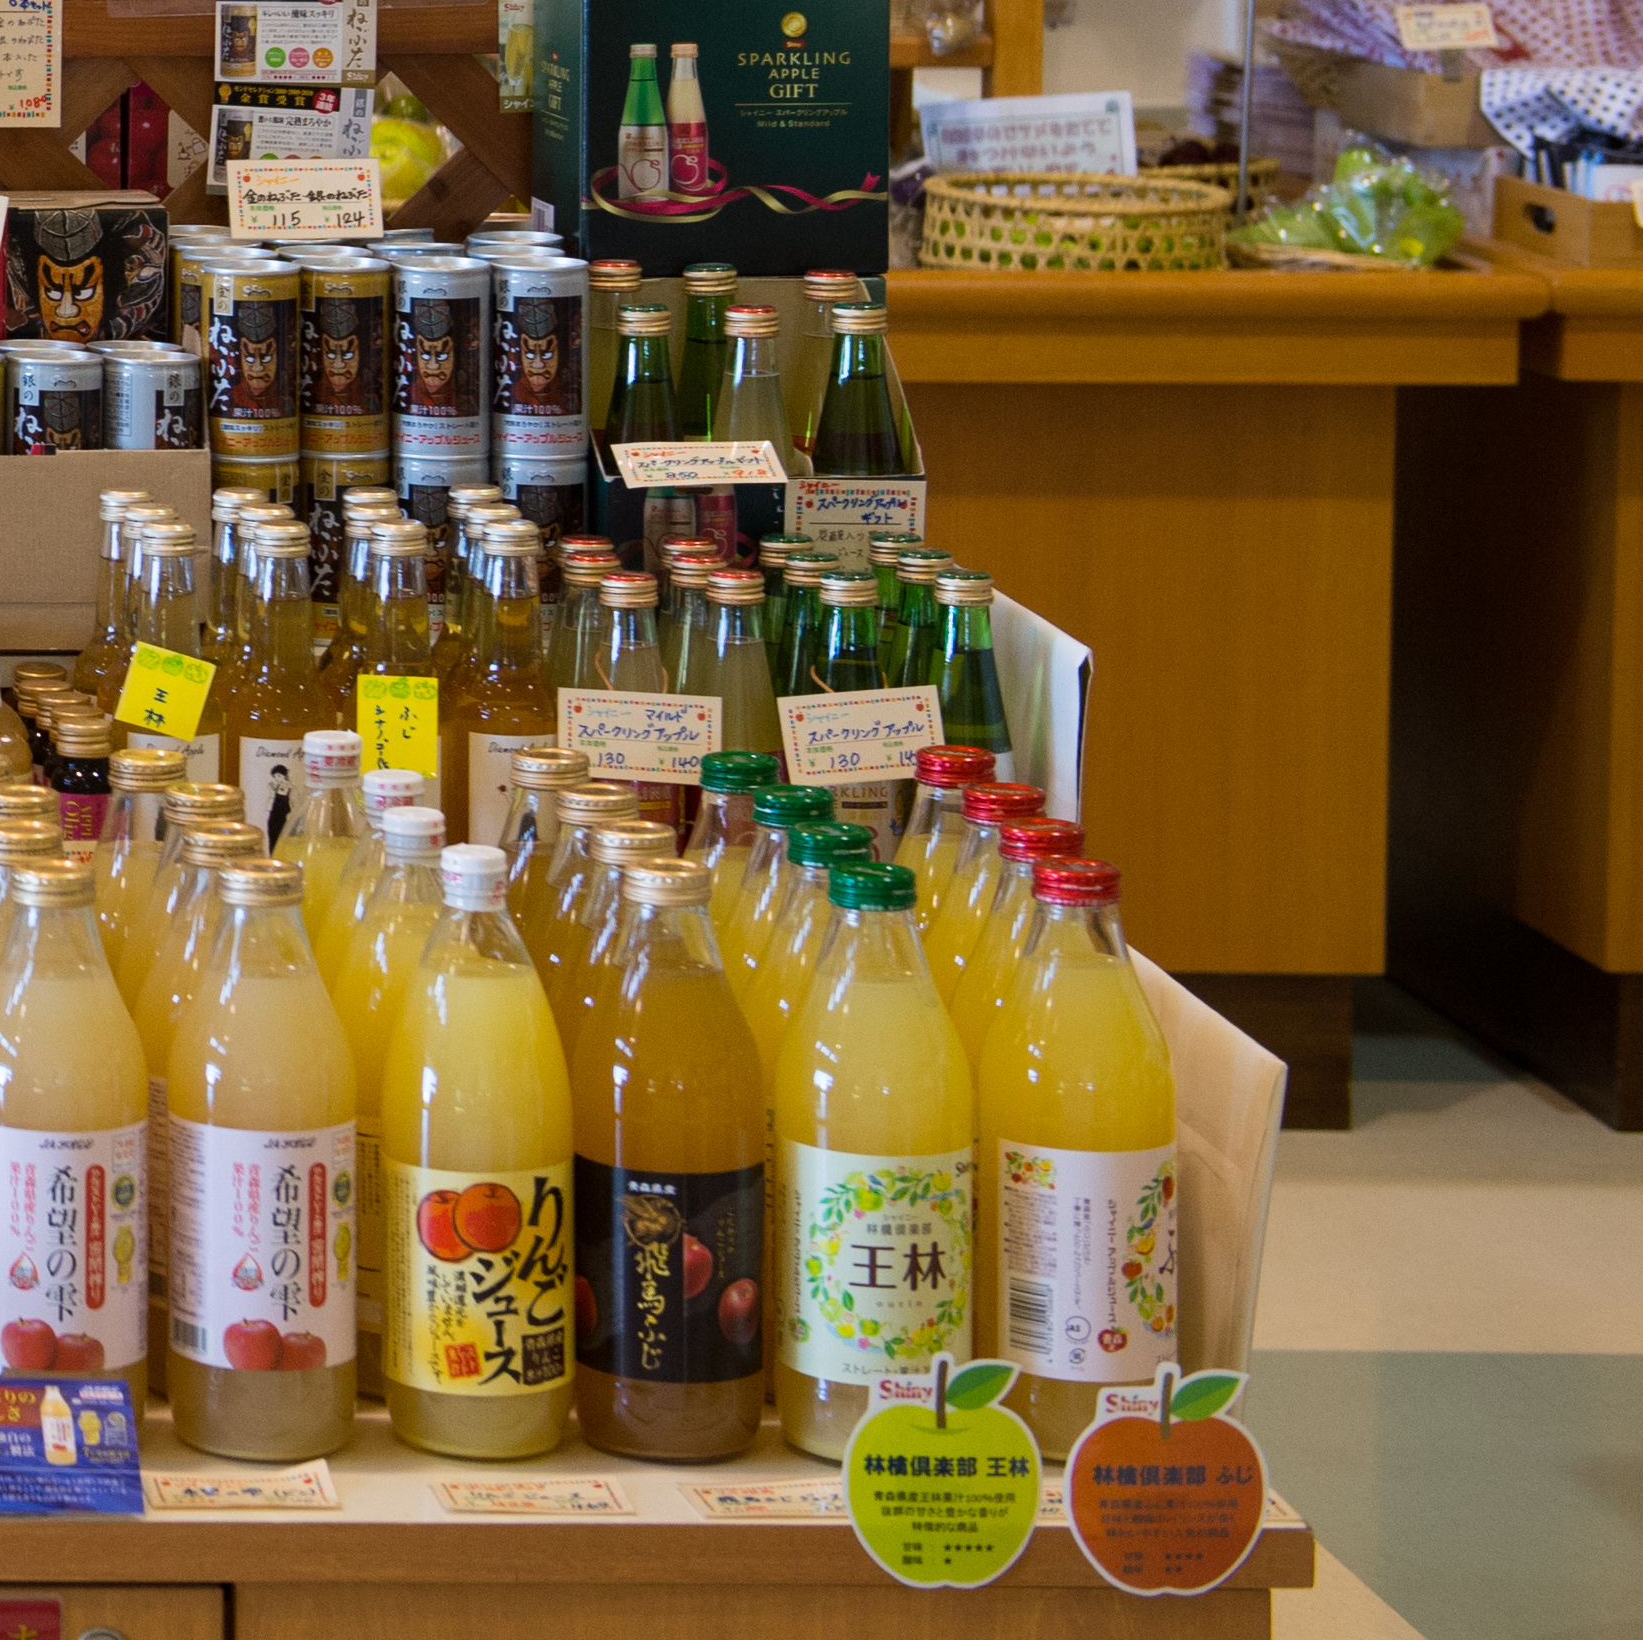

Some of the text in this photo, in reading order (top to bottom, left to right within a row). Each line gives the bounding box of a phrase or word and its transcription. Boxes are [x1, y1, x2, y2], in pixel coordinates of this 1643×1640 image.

[737, 51, 851, 67] SPARKLING
[768, 67, 821, 81] APPLE
[769, 83, 818, 99] GIFT
[272, 210, 366, 227] 115 124
[44, 1164, 81, 1324] 希望の雫
[269, 1163, 302, 1323] 希望の雫
[517, 1175, 570, 1328] りんご
[849, 1241, 948, 1291] 王林
[471, 1251, 523, 1388] ジュース
[879, 1379, 934, 1404] Shiny
[1105, 1392, 1160, 1417] Shiny
[863, 1454, 1030, 1478] 林檎倶楽部 王林
[1215, 1465, 1254, 1485] ふじ
